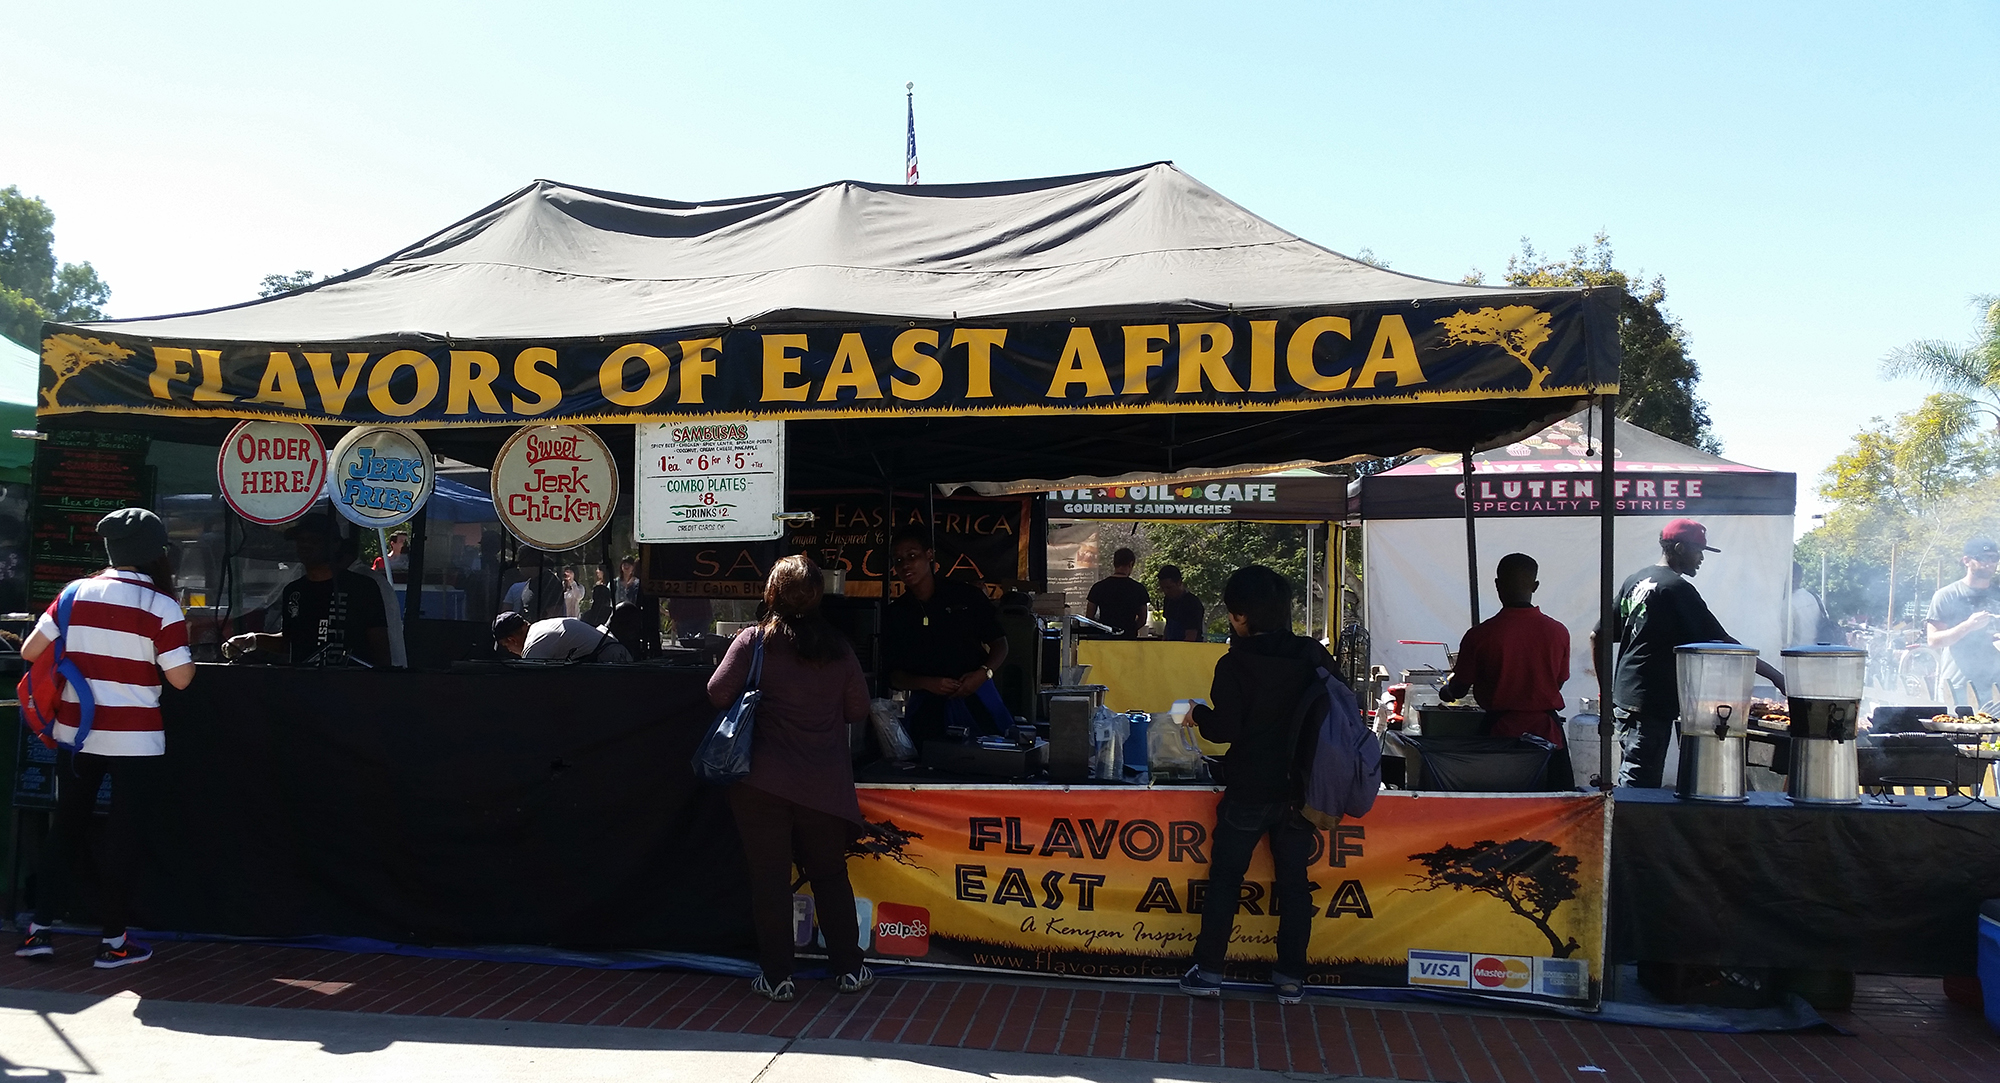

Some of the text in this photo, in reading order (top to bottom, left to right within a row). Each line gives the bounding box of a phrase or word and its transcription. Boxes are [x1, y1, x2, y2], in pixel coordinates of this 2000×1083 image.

[148, 314, 1428, 417] FLAVORS OF EAST AFRICA
[672, 424, 748, 443] SAMBUSAS
[237, 433, 311, 464] ORDER
[526, 434, 589, 466] Sweet
[350, 446, 424, 484] JERK
[698, 454, 709, 471] 6
[711, 455, 721, 466] for
[241, 459, 318, 494] HERE!
[667, 477, 746, 493] COMBO PLATES
[341, 479, 414, 513] FRIES
[1129, 484, 1174, 500] OIL
[1203, 484, 1276, 501] CAFE
[1614, 480, 1702, 498] FREE
[685, 508, 717, 518] DRINKS
[1064, 503, 1232, 515] GOURMET SANDWICHES
[1473, 500, 1686, 512] SPECIALTY PSTRIES
[834, 502, 896, 529] EAST
[677, 524, 697, 532] CREDIT
[788, 532, 818, 546] enyan
[824, 530, 870, 546] Inspired
[686, 582, 697, 593] El
[703, 582, 738, 595] Cajon
[743, 582, 765, 594] Blv
[316, 618, 328, 646] EST.
[968, 816, 1208, 864] FLAVOR
[955, 863, 1374, 919] EAST AFRIA
[1020, 916, 1037, 933] A
[1045, 917, 1124, 948] Kenyan
[1420, 962, 1461, 977] VISA
[1474, 968, 1529, 980] MasterCard
